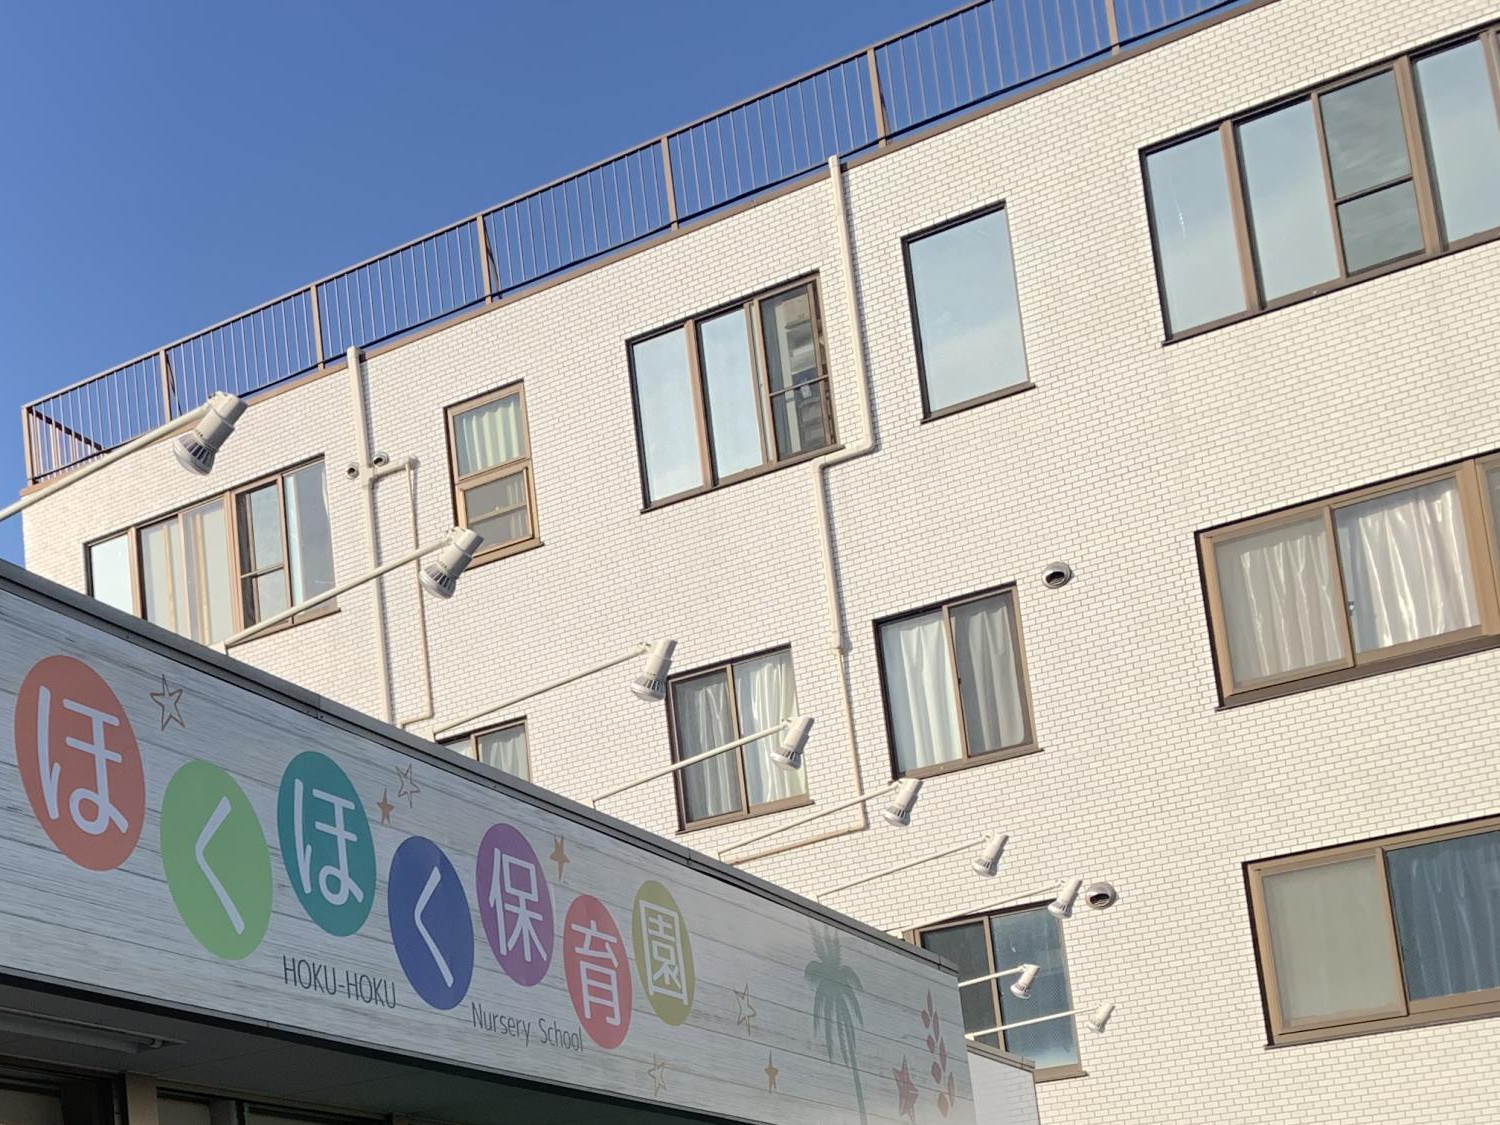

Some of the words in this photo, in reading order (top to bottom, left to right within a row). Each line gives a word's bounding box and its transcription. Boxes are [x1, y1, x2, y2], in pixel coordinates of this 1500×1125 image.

[37, 684, 691, 1028] ほくほく保育園
[283, 955, 396, 1009] HOKU-HOKU
[471, 1002, 531, 1046] Nursery
[538, 1017, 584, 1053] School
